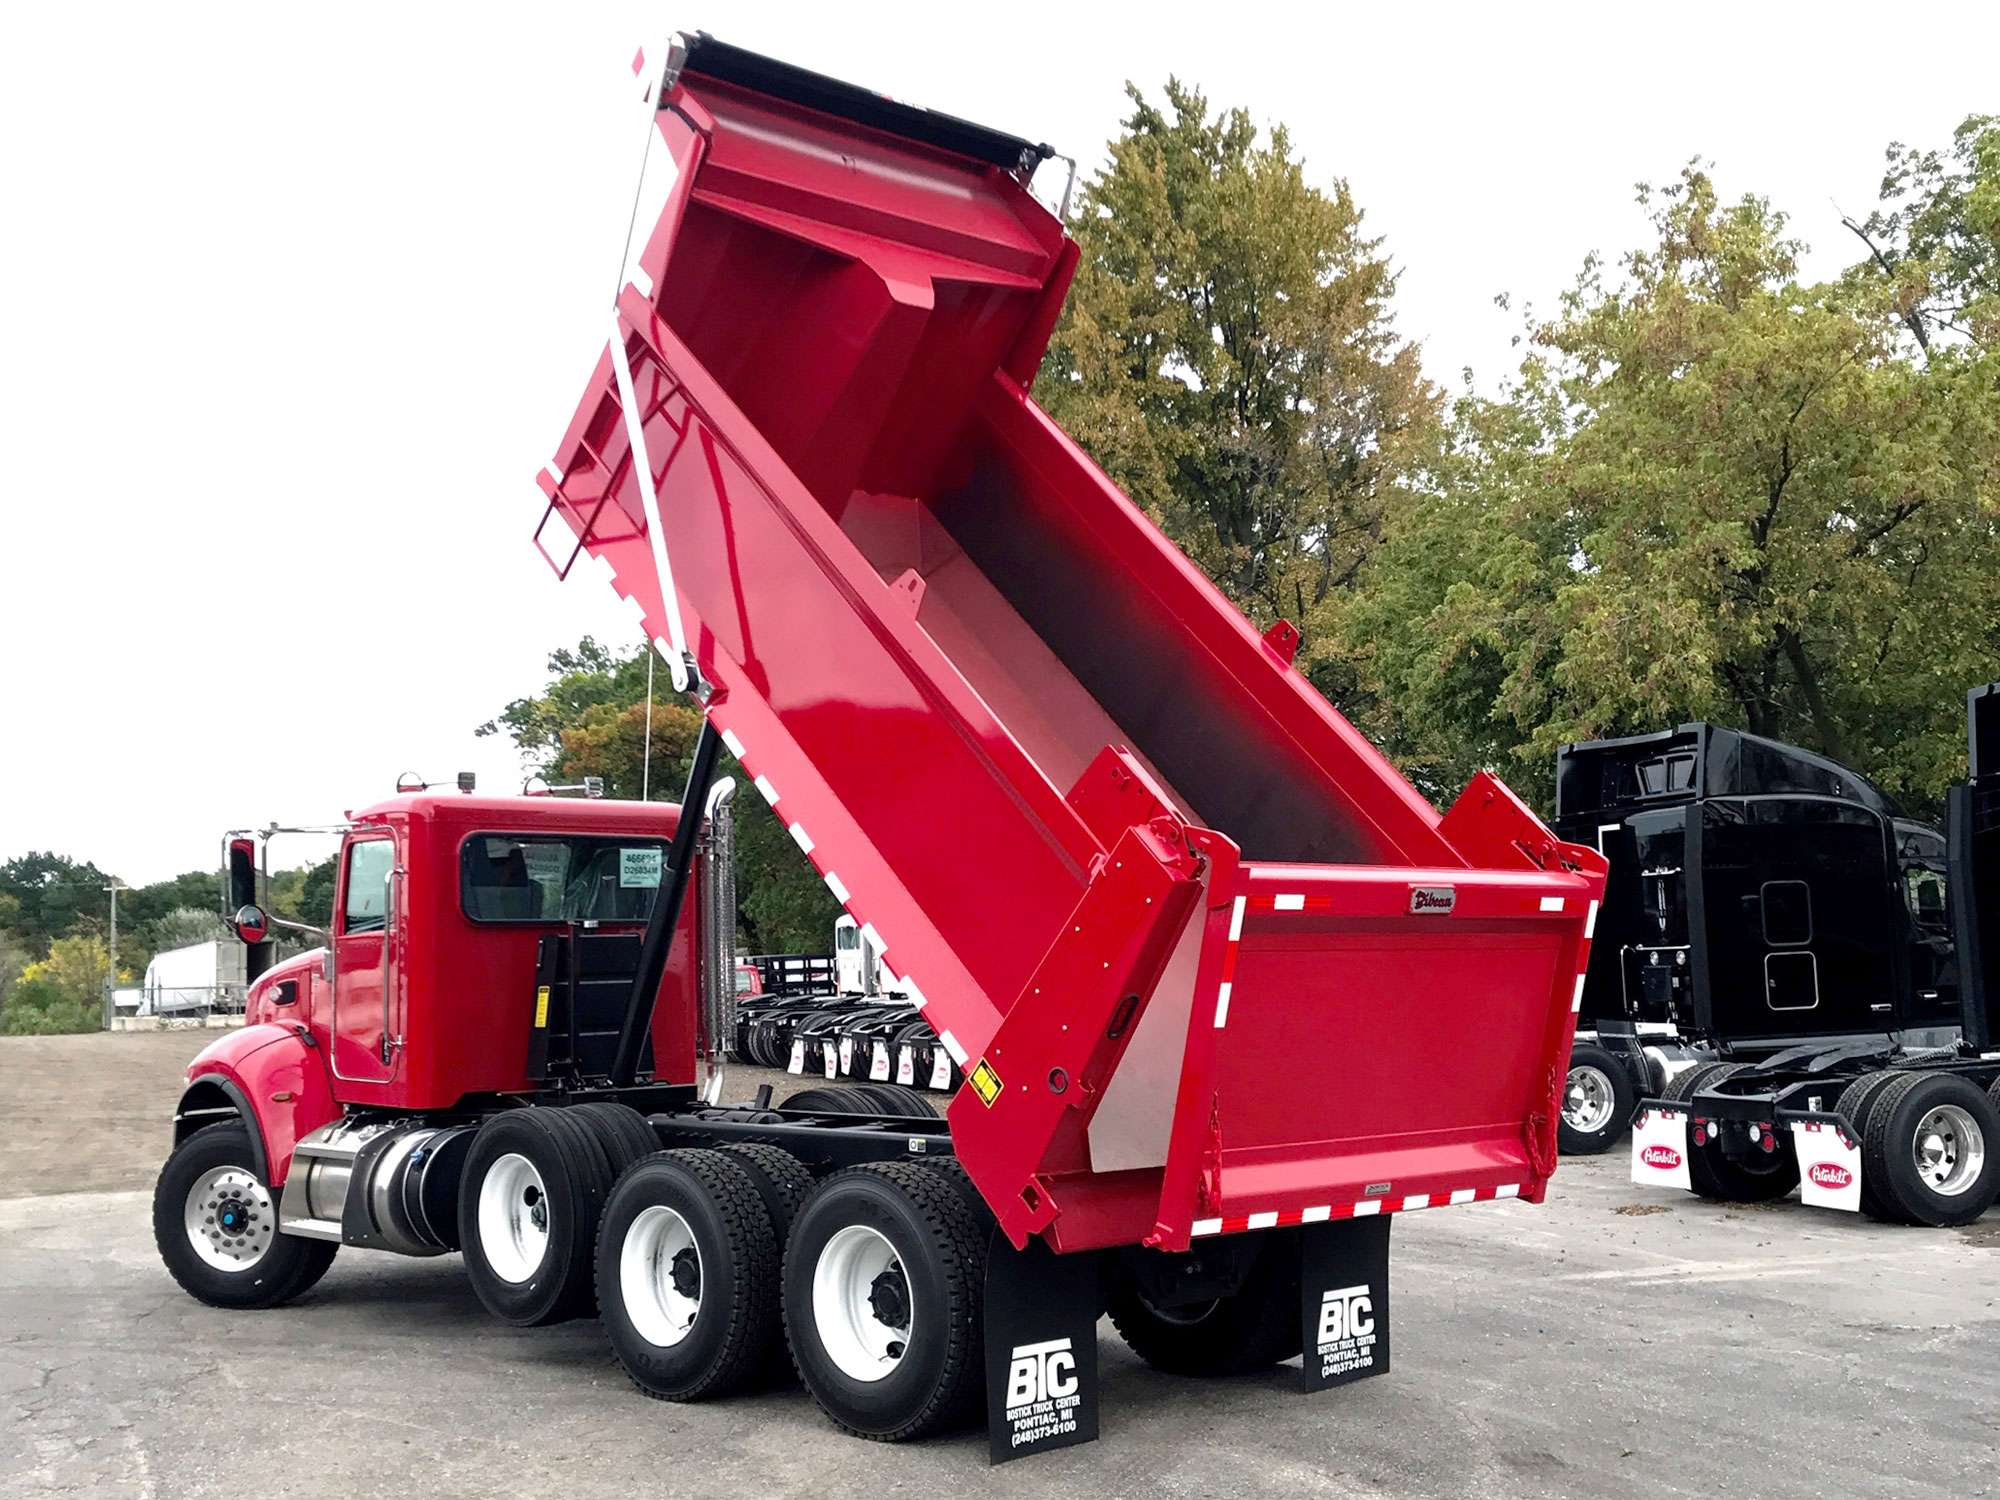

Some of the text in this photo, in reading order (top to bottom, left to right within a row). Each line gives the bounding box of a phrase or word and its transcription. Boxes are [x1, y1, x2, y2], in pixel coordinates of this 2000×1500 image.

[1644, 1148, 1679, 1165] Peterbilt
[1811, 1166, 1848, 1185] Peterbilt
[1317, 1284, 1375, 1345] BTC
[1317, 1334, 1376, 1355] BOSTICK TRUCK CENTER
[1323, 1346, 1370, 1365] PONTIAC, MI
[1006, 1337, 1079, 1409] BTC
[1321, 1356, 1373, 1379] (248)373-6100
[1006, 1395, 1080, 1421] BOSTICK TRUCK CENTER
[1014, 1408, 1073, 1432] PONTIAC, MI
[1011, 1420, 1077, 1448] (248)373-6100
